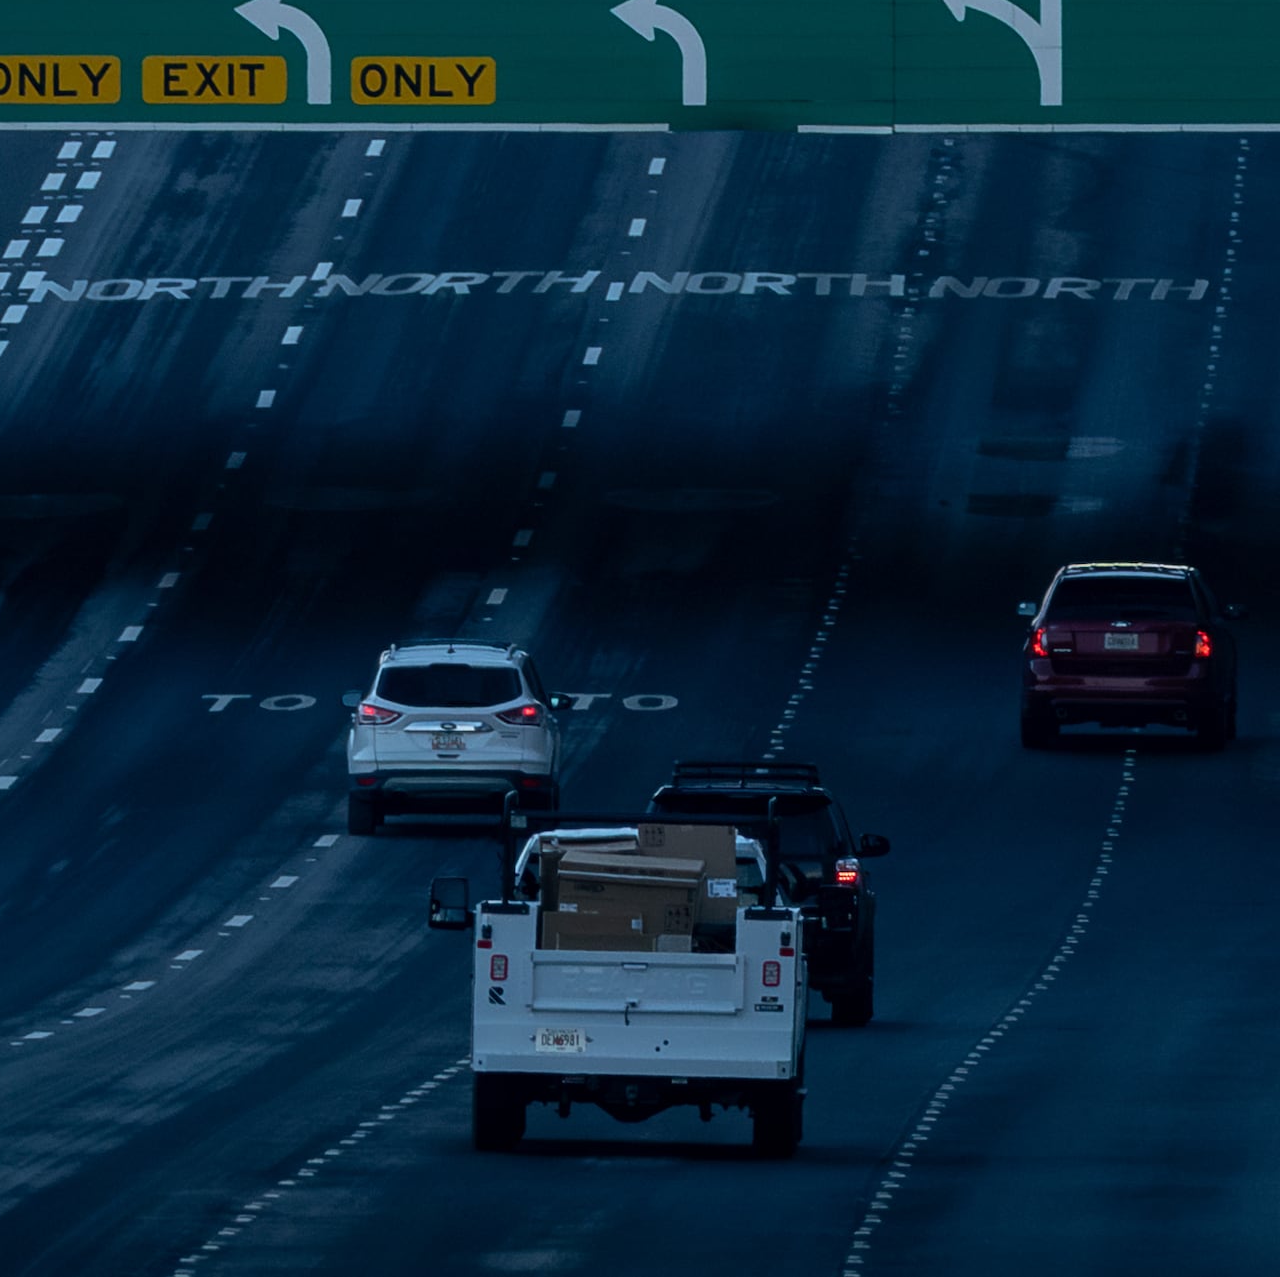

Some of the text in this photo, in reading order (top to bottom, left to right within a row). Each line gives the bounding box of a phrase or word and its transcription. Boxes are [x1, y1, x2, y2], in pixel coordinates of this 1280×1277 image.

[164, 63, 264, 96] EXIT
[360, 64, 486, 97] ONLY
[33, 273, 306, 304] NORTH
[323, 269, 602, 300] NORTH
[630, 270, 906, 298] NORTH
[927, 274, 1210, 302] NORTH
[202, 692, 317, 713] TO
[569, 692, 679, 712] TO
